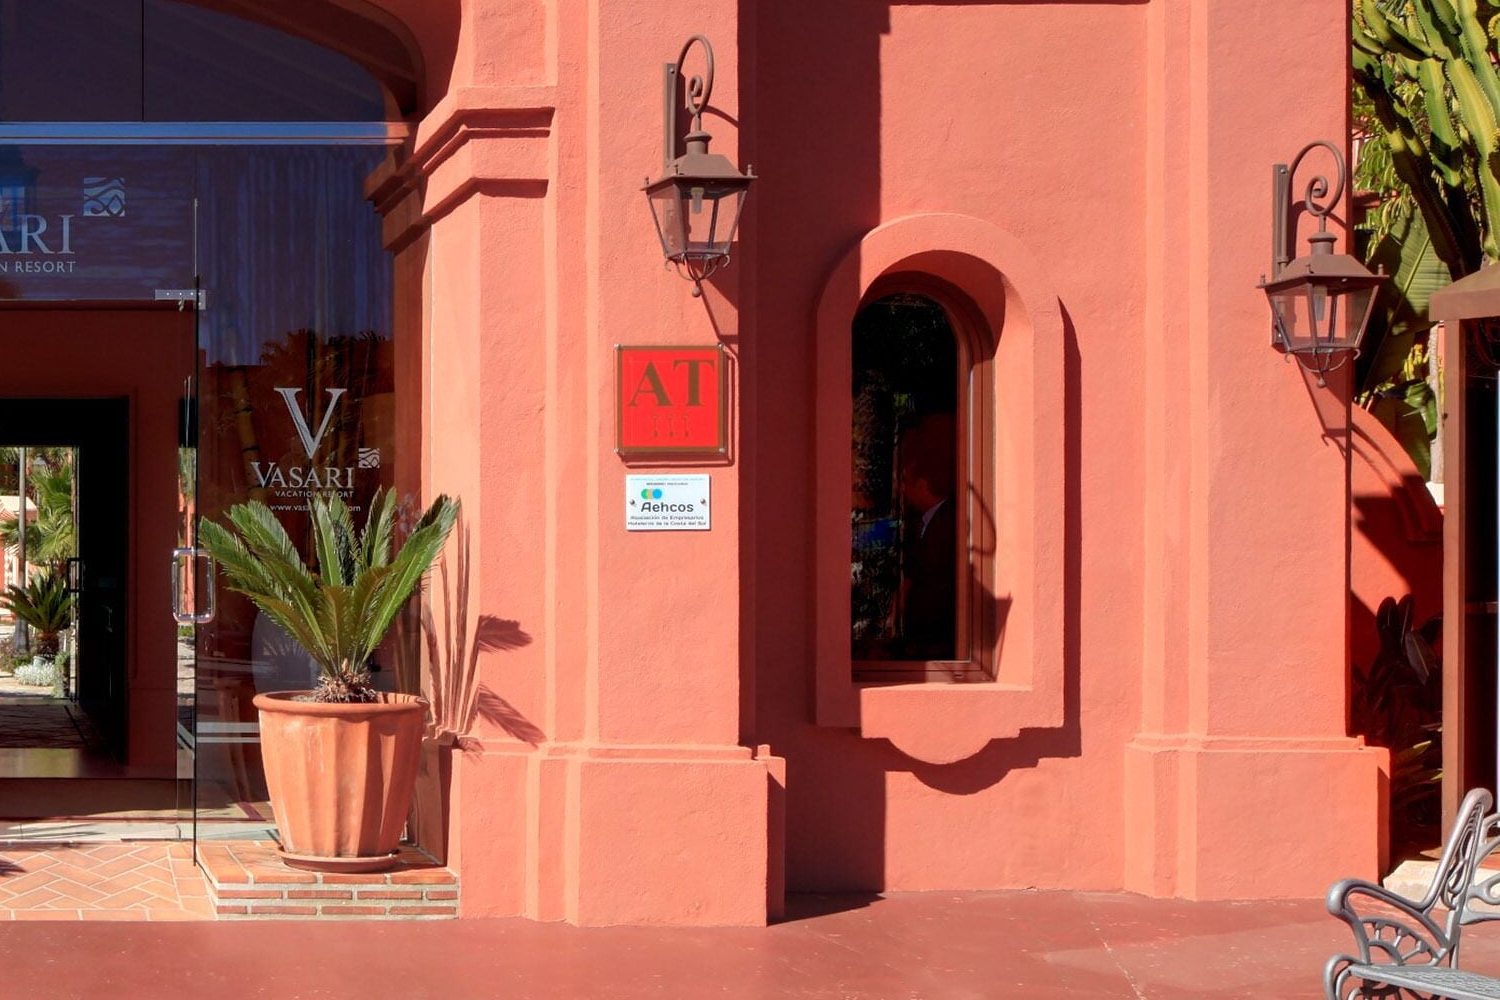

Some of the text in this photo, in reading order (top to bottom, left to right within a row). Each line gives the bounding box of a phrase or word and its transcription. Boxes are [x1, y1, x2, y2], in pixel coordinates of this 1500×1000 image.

[15, 261, 77, 273] RESORT
[627, 359, 716, 407] AT
[273, 387, 348, 460] V
[250, 461, 356, 489] VASARI
[641, 501, 694, 513] Aehcos
